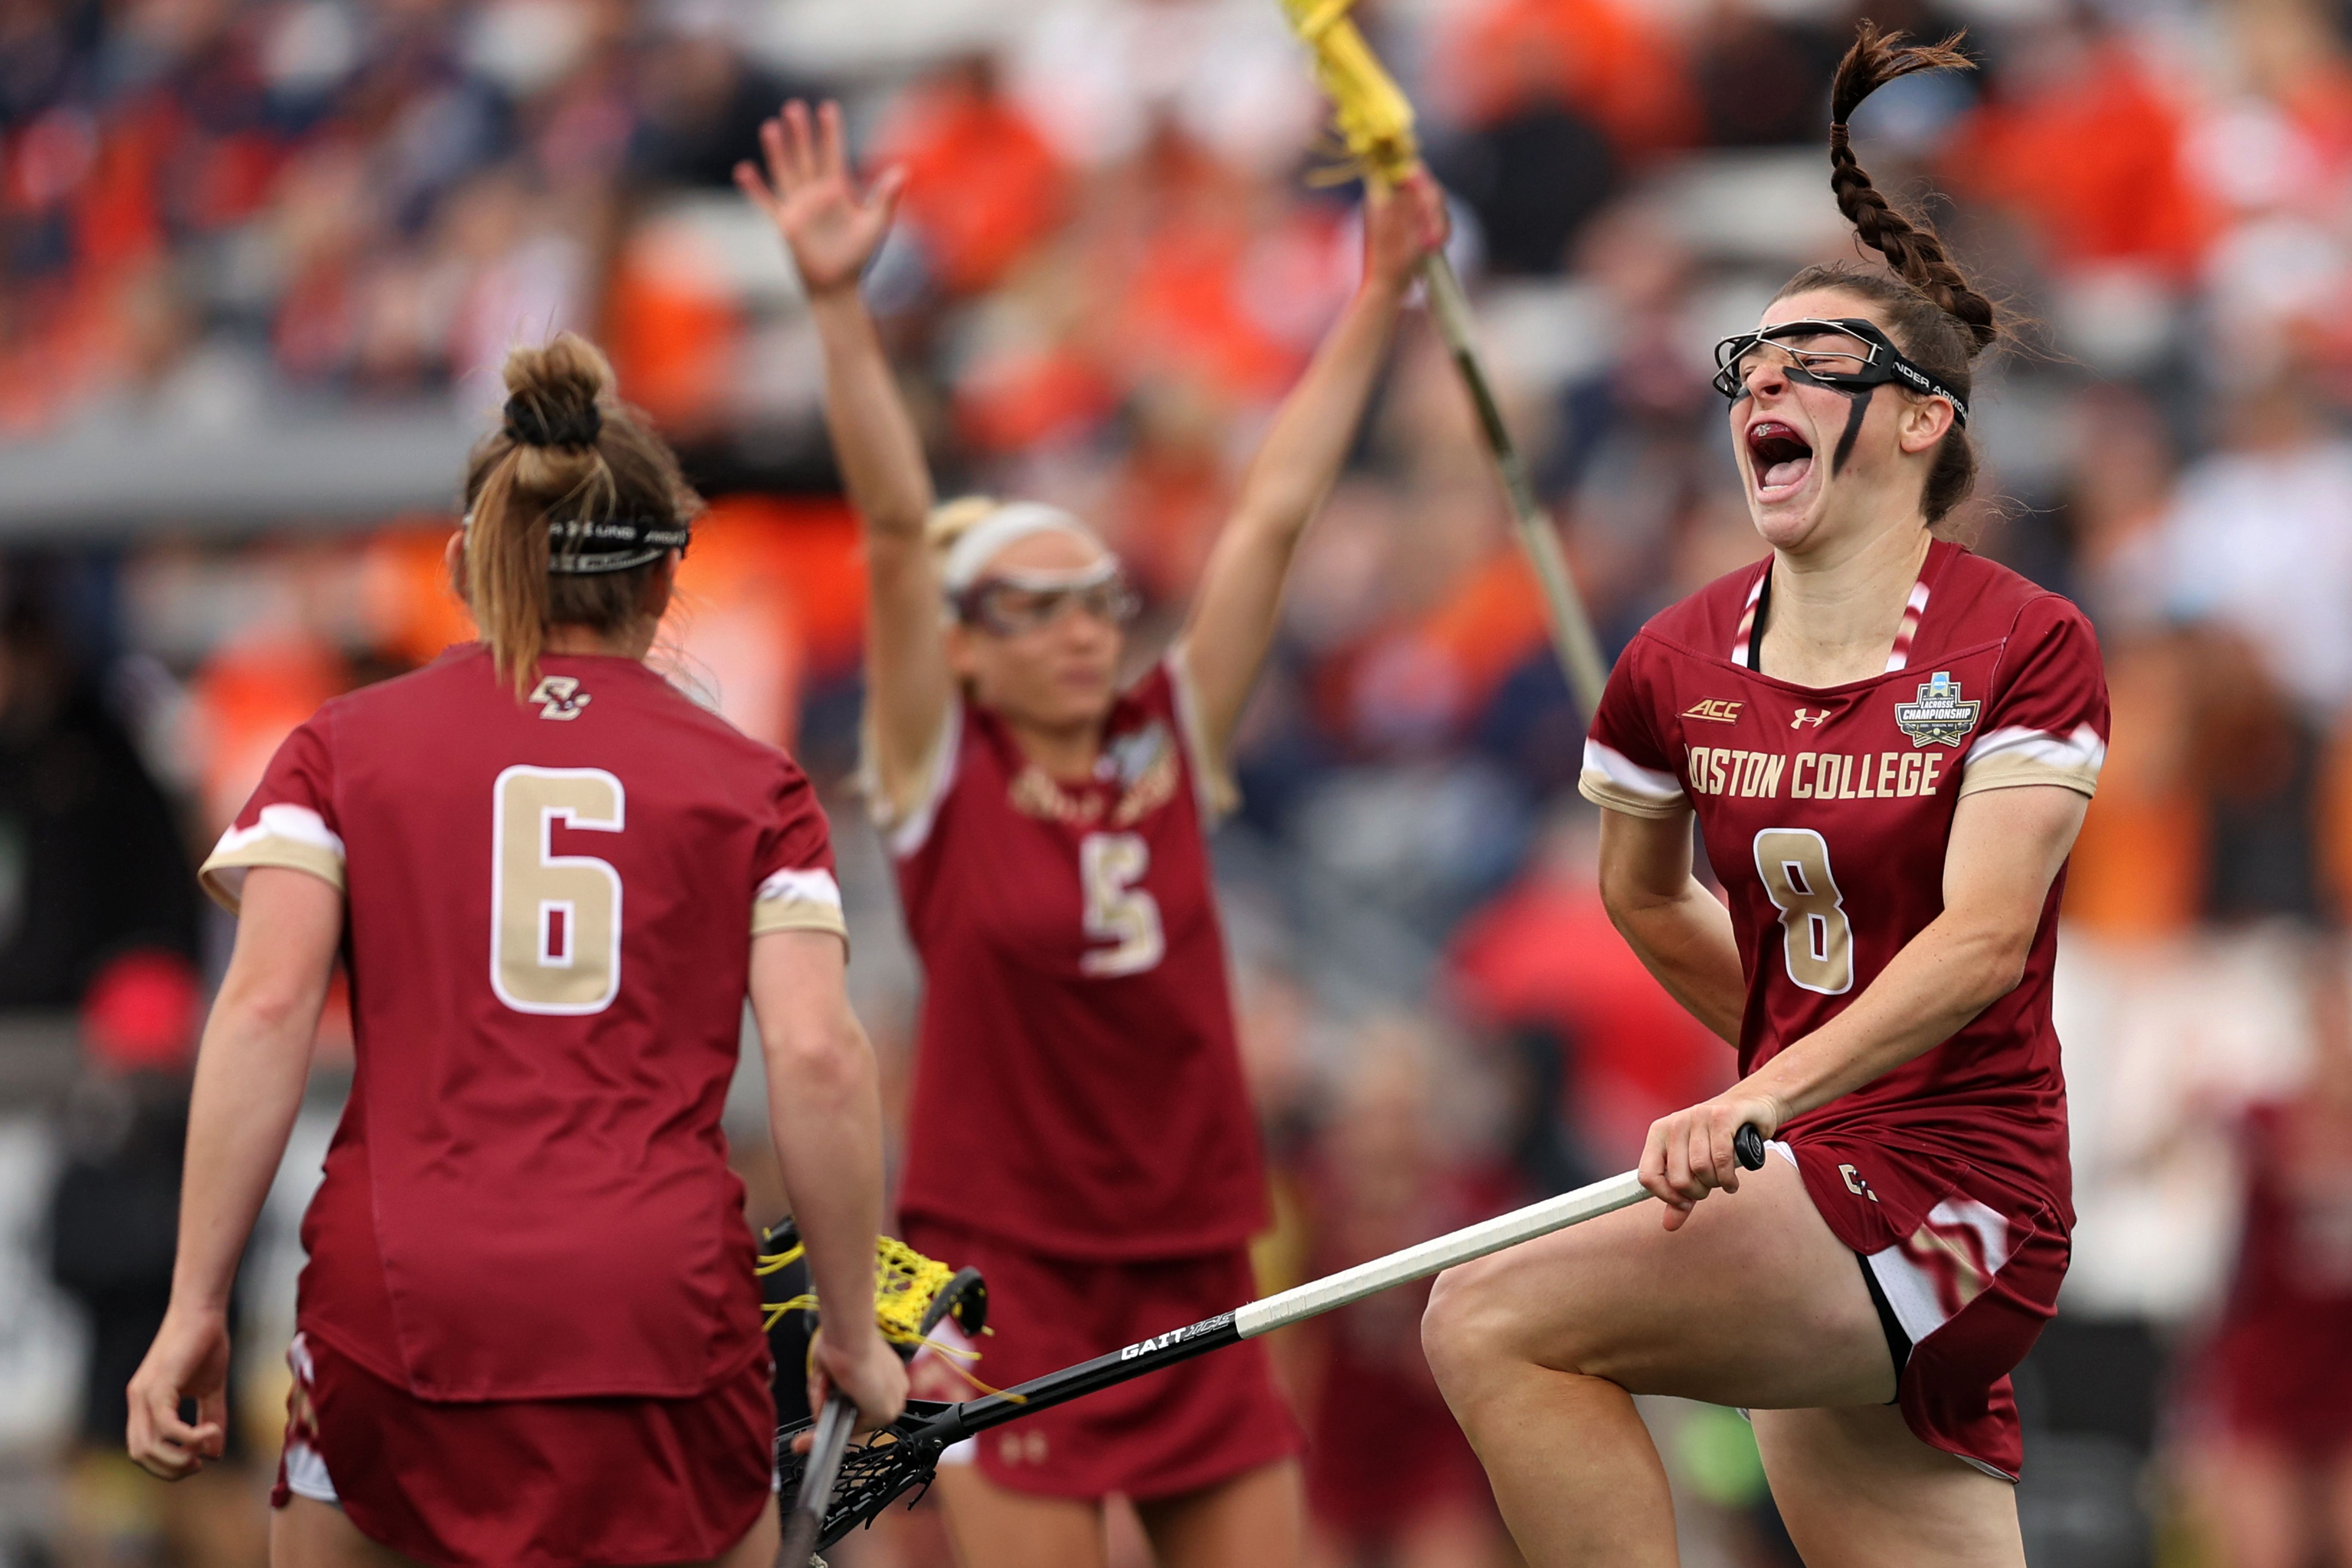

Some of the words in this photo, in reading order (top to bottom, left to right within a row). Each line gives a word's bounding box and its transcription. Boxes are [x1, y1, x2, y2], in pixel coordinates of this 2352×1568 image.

[1892, 361, 1930, 388] NDER
[1687, 699, 1743, 718] ACC
[1903, 708, 1971, 720] CHAMPIONSHIP
[1920, 700, 1954, 709] LACROSSE
[1684, 743, 1786, 798] OSTON
[1791, 752, 1943, 799] COLLEGE
[490, 764, 625, 1016] 6
[1078, 830, 1167, 977] 5
[1753, 828, 1854, 995] 8
[1121, 1327, 1186, 1360] GAIT
